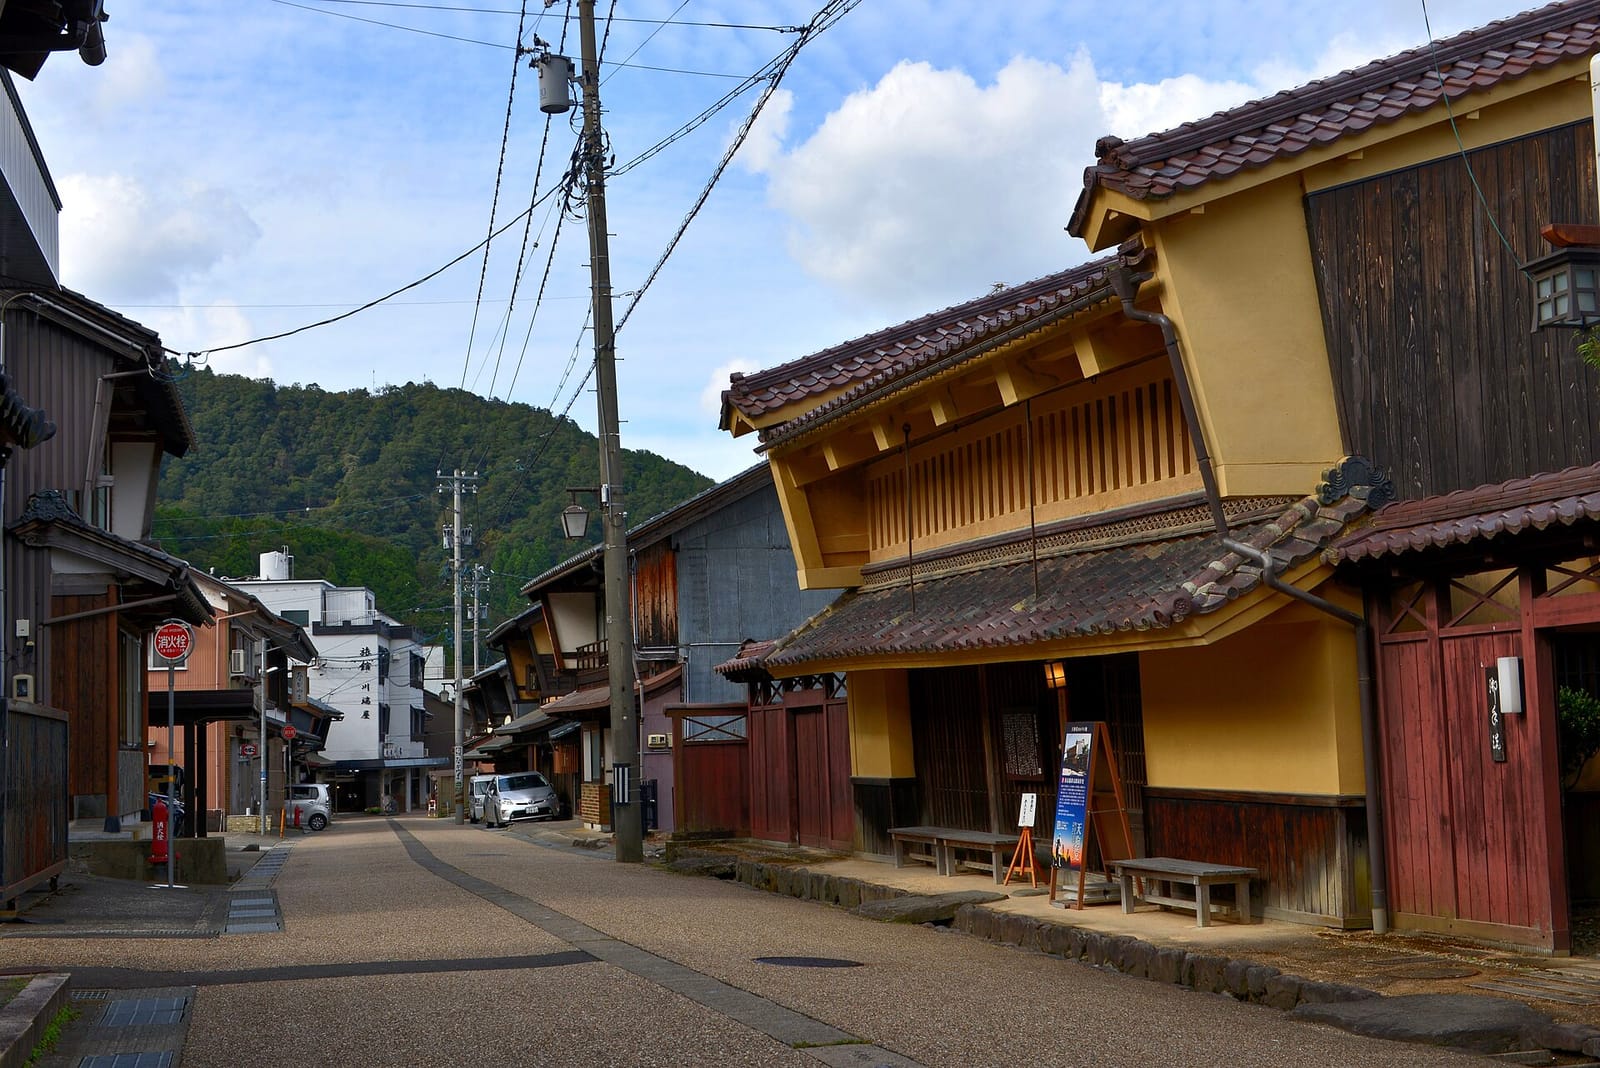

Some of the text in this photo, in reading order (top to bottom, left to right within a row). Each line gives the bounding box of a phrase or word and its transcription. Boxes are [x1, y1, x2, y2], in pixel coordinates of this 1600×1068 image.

[158, 634, 187, 649] 消火栓
[360, 683, 372, 720] 川端屋
[157, 821, 165, 841] 消火栓
